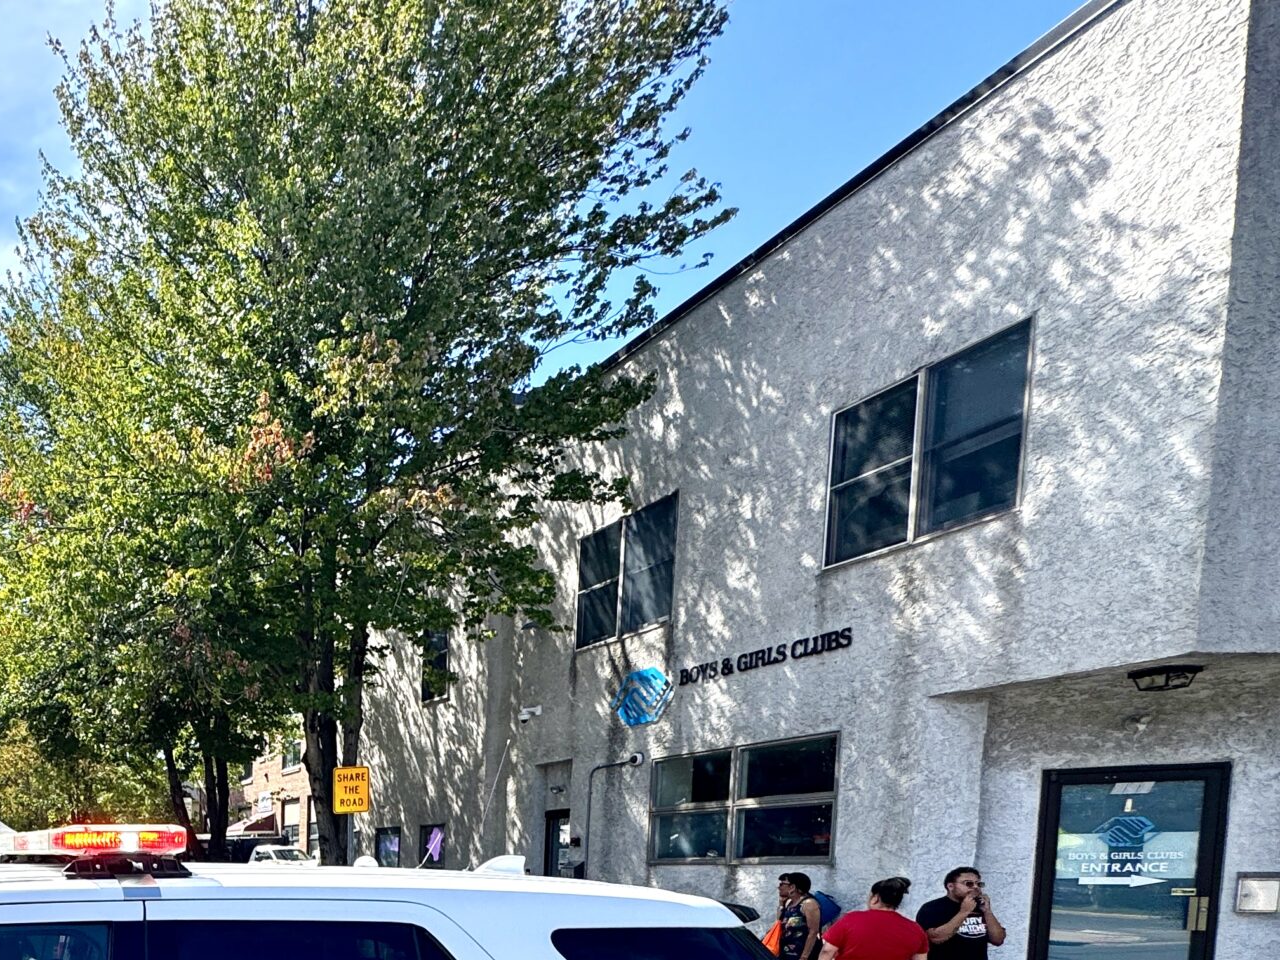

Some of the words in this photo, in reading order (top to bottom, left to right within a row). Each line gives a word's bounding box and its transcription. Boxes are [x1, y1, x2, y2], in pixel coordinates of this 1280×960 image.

[679, 660, 718, 686] BOYS
[721, 658, 733, 676] &
[736, 643, 787, 672] GIRLS
[790, 626, 852, 659] CLUBS
[337, 772, 366, 782] SHARE
[344, 785, 360, 794] THE
[339, 798, 364, 807] ROAD
[1068, 852, 1097, 860] BOYS
[1111, 851, 1144, 860] GIRLS
[1146, 851, 1184, 859] CLUBS
[1081, 862, 1169, 873] ENTRANCE
